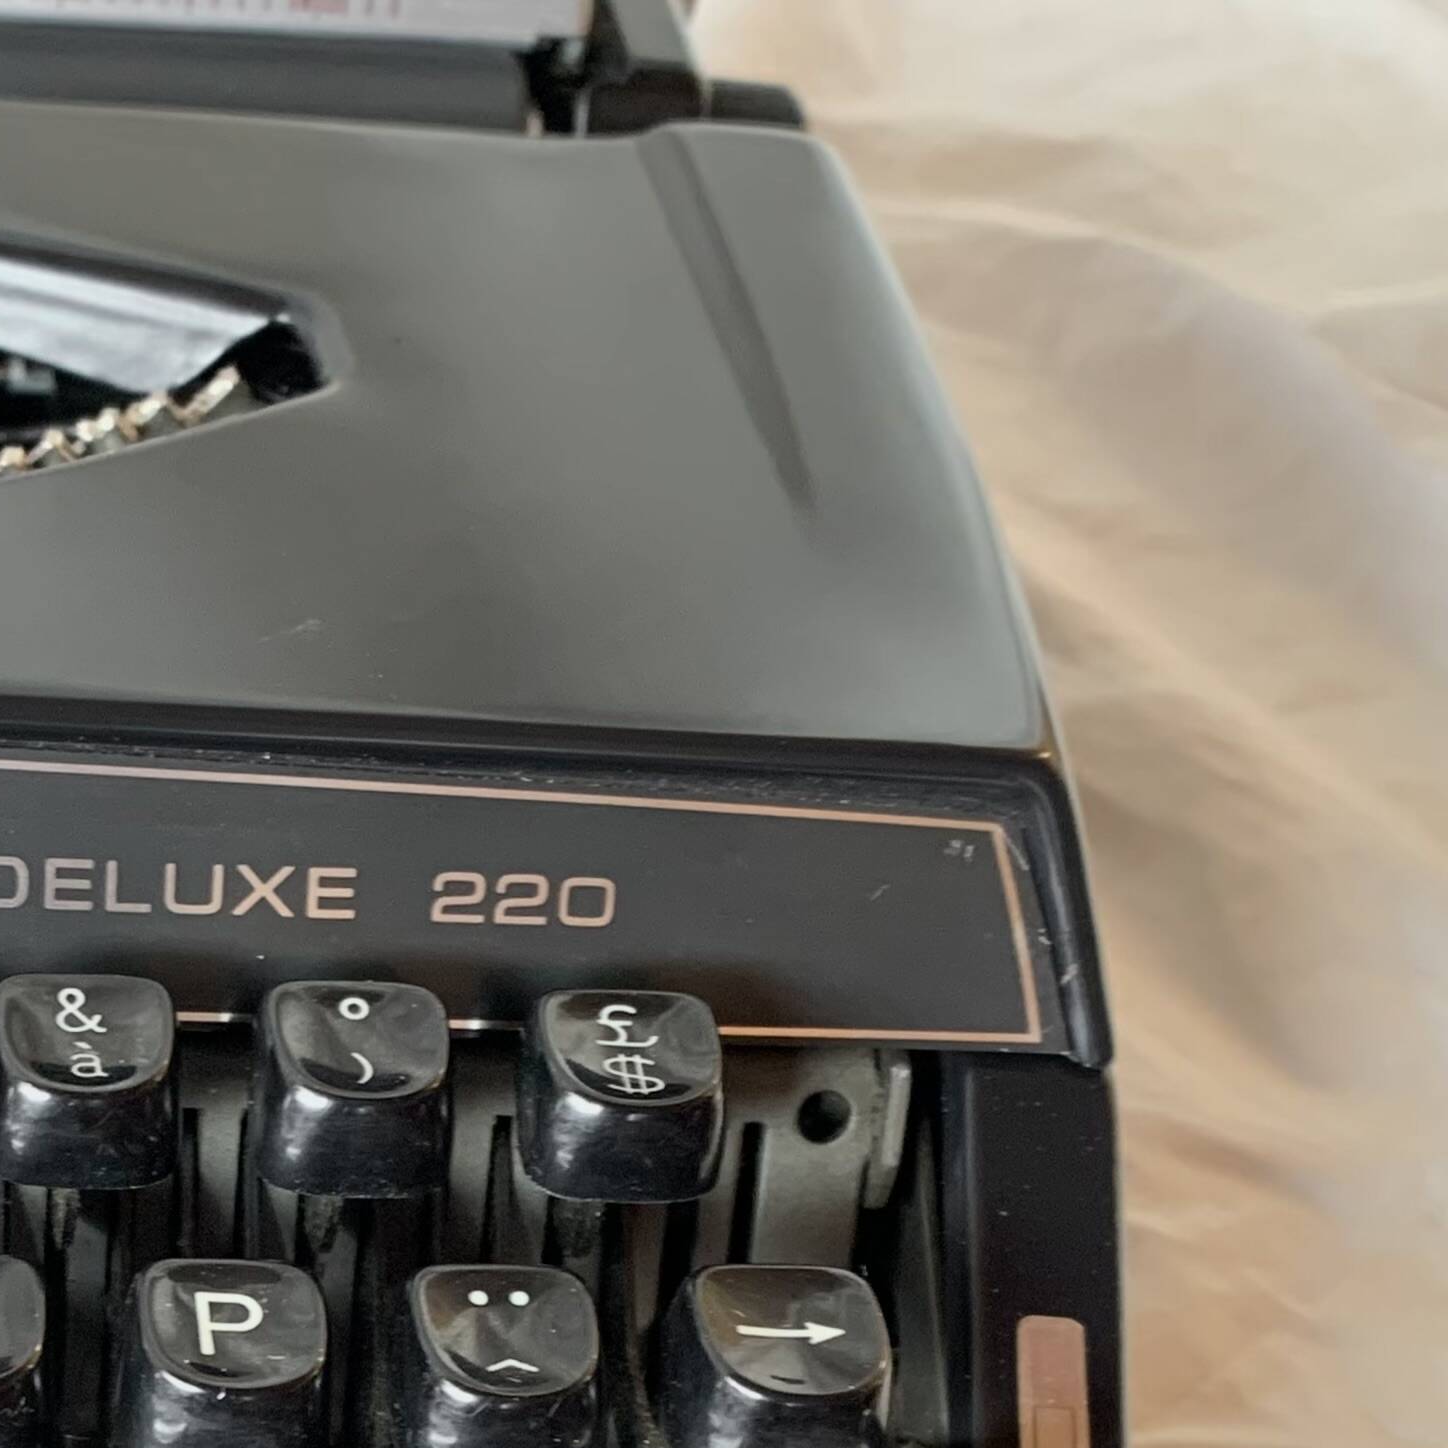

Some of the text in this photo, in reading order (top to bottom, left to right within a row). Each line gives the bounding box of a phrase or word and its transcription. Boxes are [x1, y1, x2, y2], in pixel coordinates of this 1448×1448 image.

[431, 871, 615, 927] 220
[55, 987, 107, 1033] &
[69, 1041, 109, 1078] à
[350, 1052, 374, 1084] )
[600, 1053, 665, 1094] $
[194, 1291, 264, 1355] P
